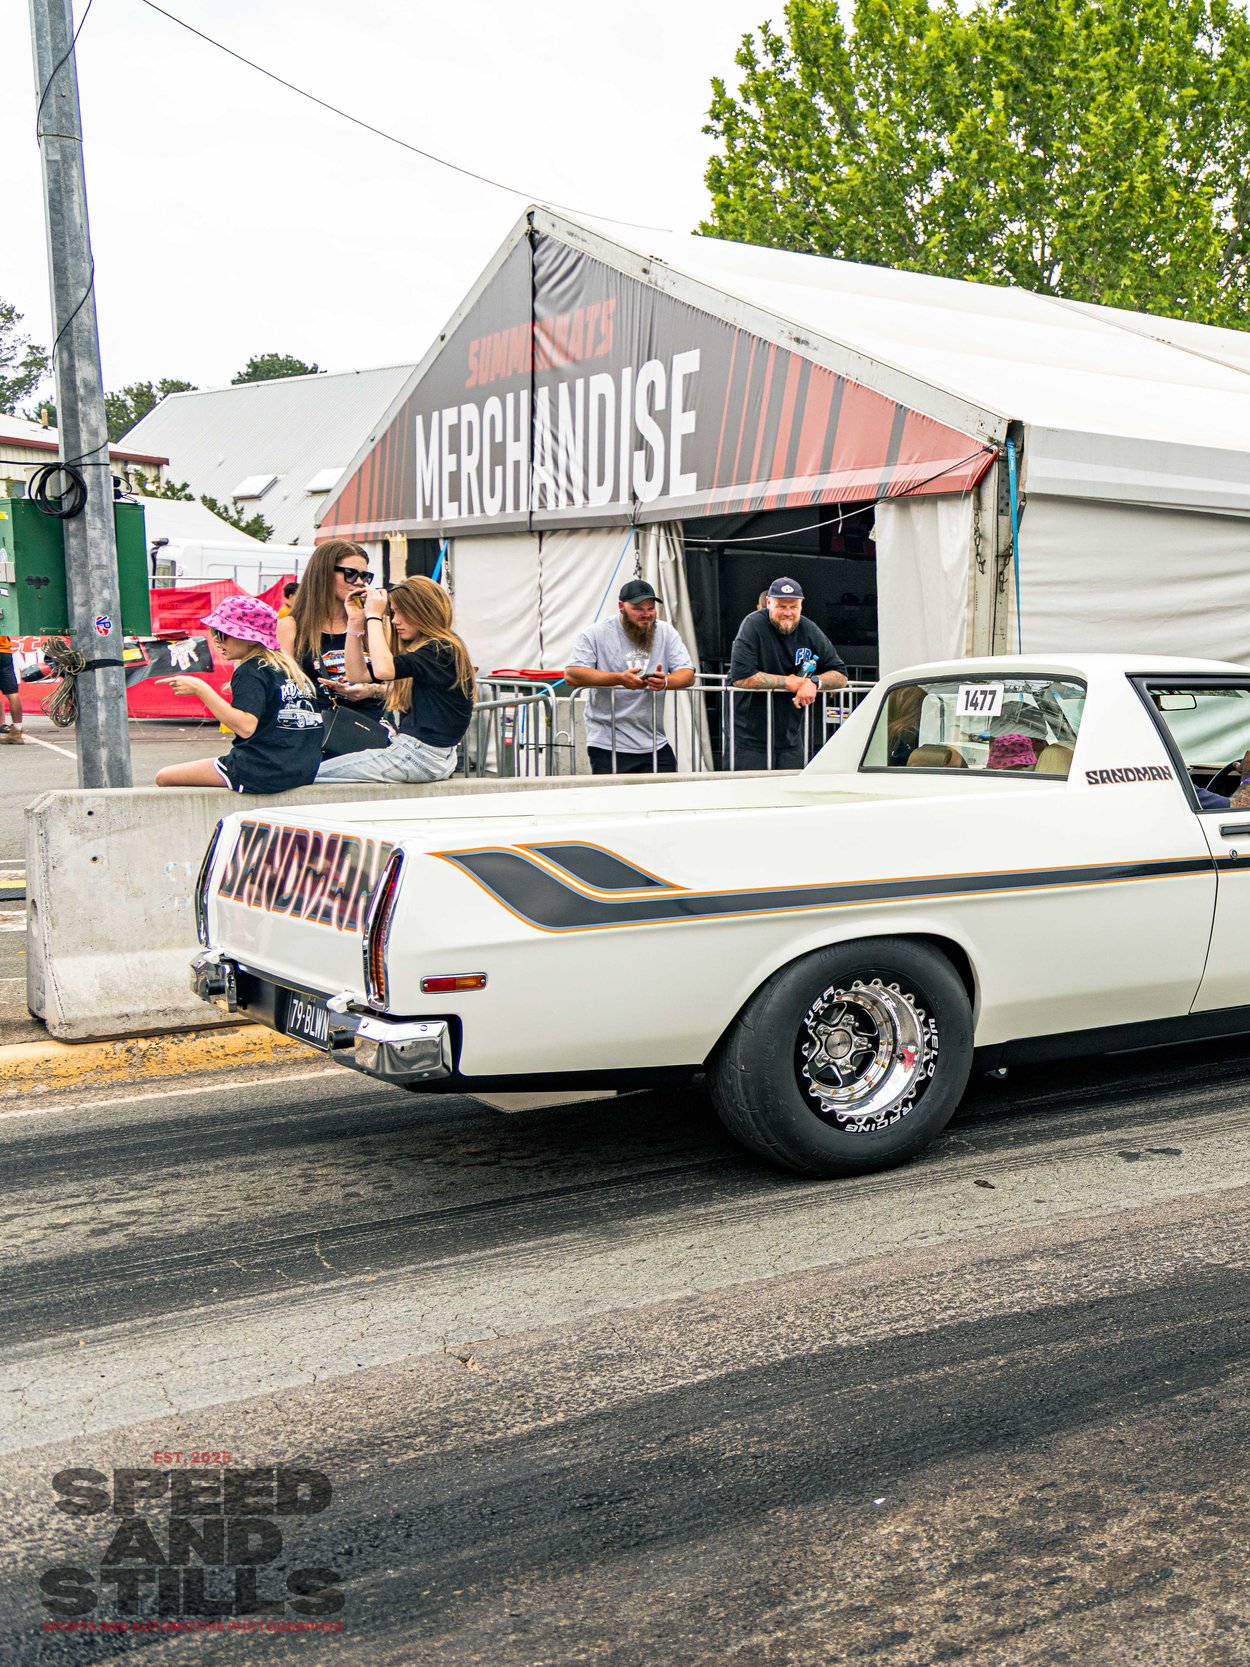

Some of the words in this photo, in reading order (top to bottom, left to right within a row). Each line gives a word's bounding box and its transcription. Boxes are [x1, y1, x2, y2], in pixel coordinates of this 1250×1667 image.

[415, 348, 701, 522] MERCHANDISE
[964, 689, 997, 711] 1477
[1085, 765, 1174, 786] SANDMAN
[218, 819, 397, 934] SANDMAN
[803, 985, 836, 1026] USA
[927, 1017, 941, 1079] WELD
[844, 1100, 914, 1134] RACING
